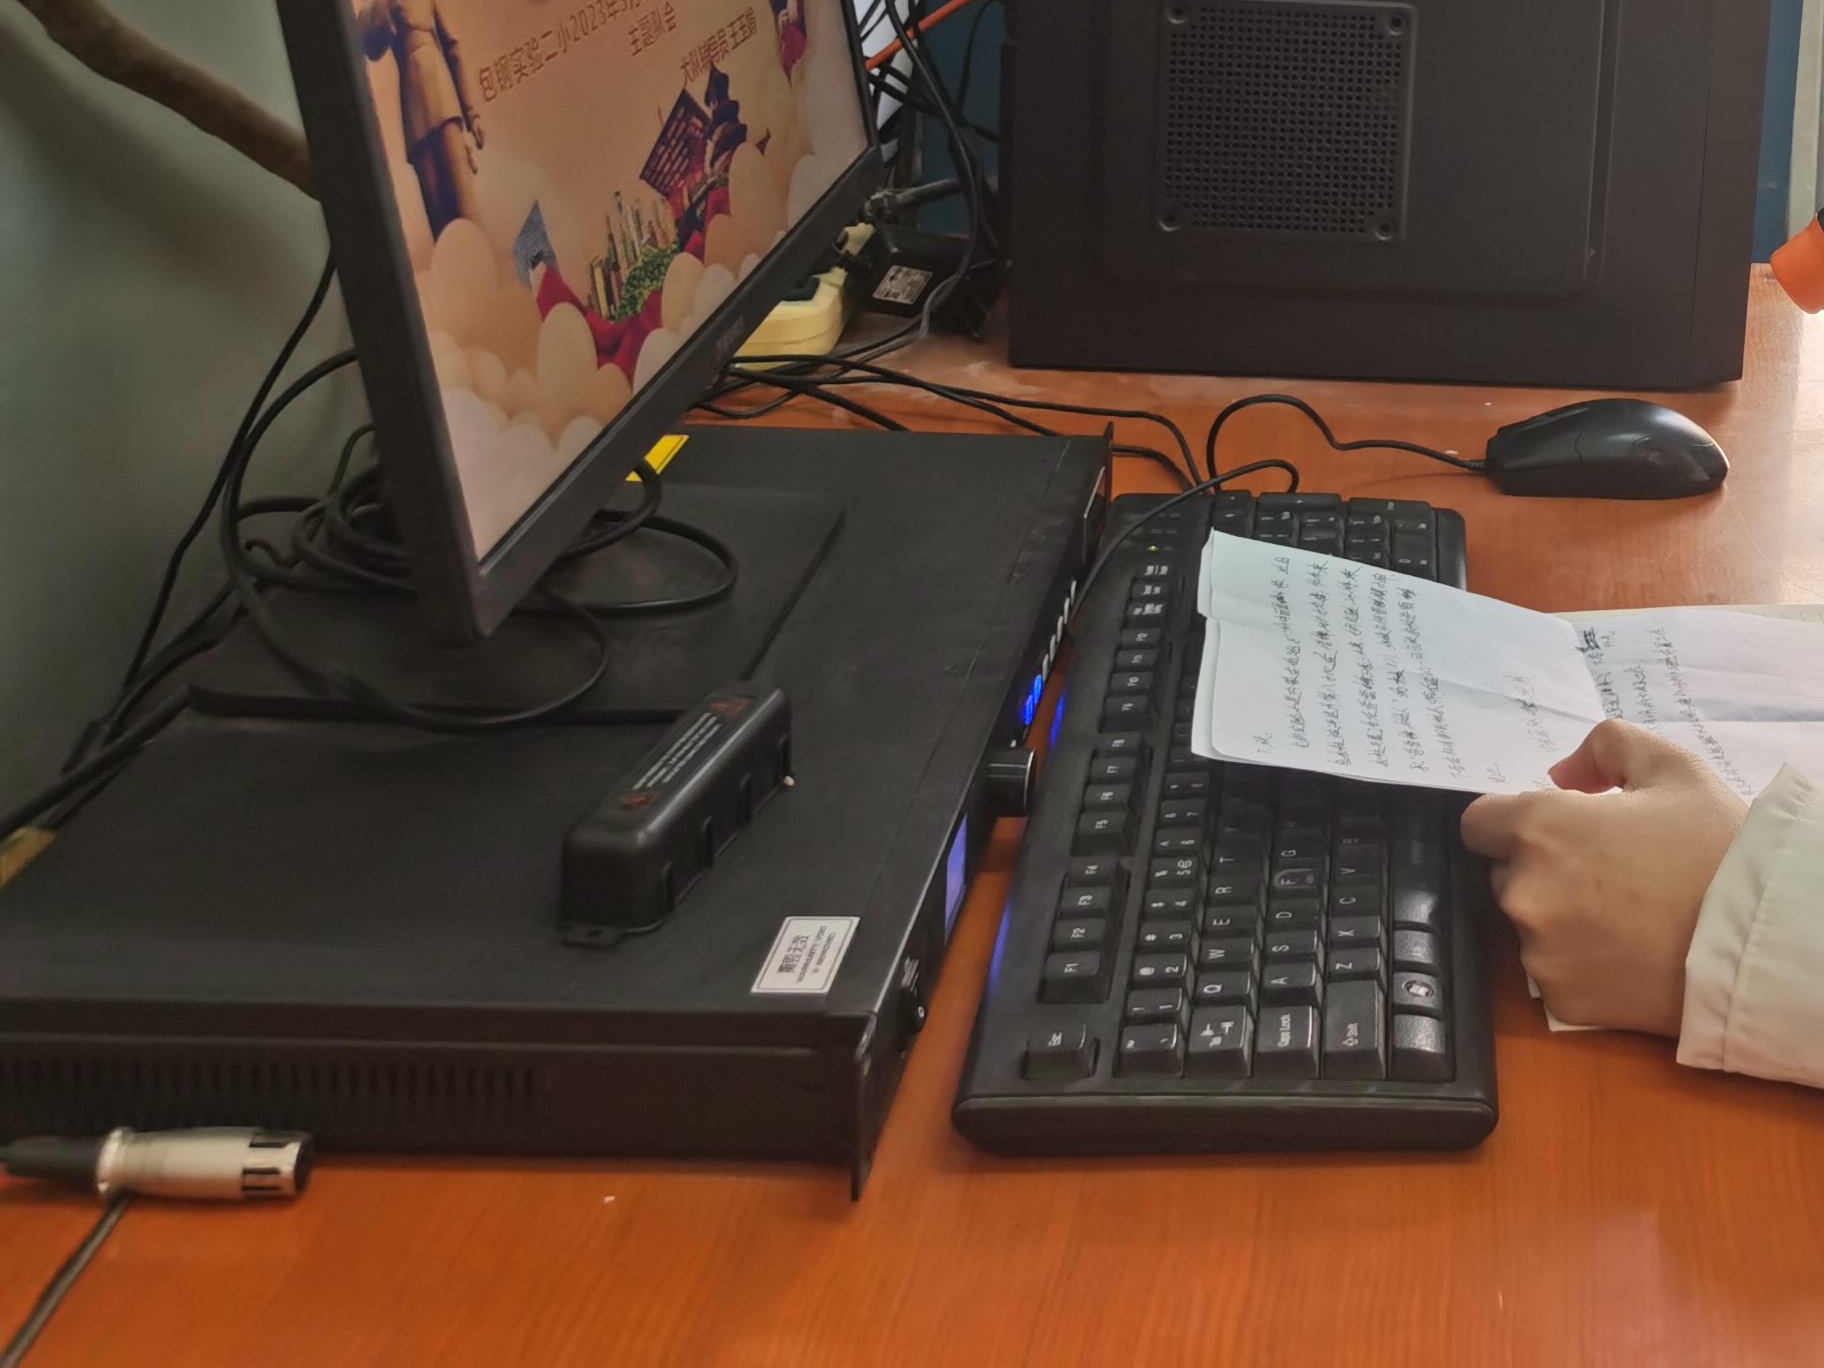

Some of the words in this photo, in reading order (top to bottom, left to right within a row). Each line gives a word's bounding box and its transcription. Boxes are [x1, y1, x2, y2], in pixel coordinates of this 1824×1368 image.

[628, 0, 677, 57] 主题队会
[1280, 849, 1297, 857] G
[1340, 867, 1357, 875] V
[1215, 885, 1233, 895] R
[1339, 896, 1357, 905] C
[1275, 911, 1293, 919] D
[1212, 917, 1231, 926] E
[1071, 926, 1087, 939] F2
[1338, 929, 1355, 938] X
[1271, 944, 1290, 953] S
[1208, 948, 1226, 960] W
[1064, 961, 1080, 974] F1
[1335, 961, 1354, 971] Z
[1270, 976, 1288, 985] A
[1203, 983, 1222, 995] Q
